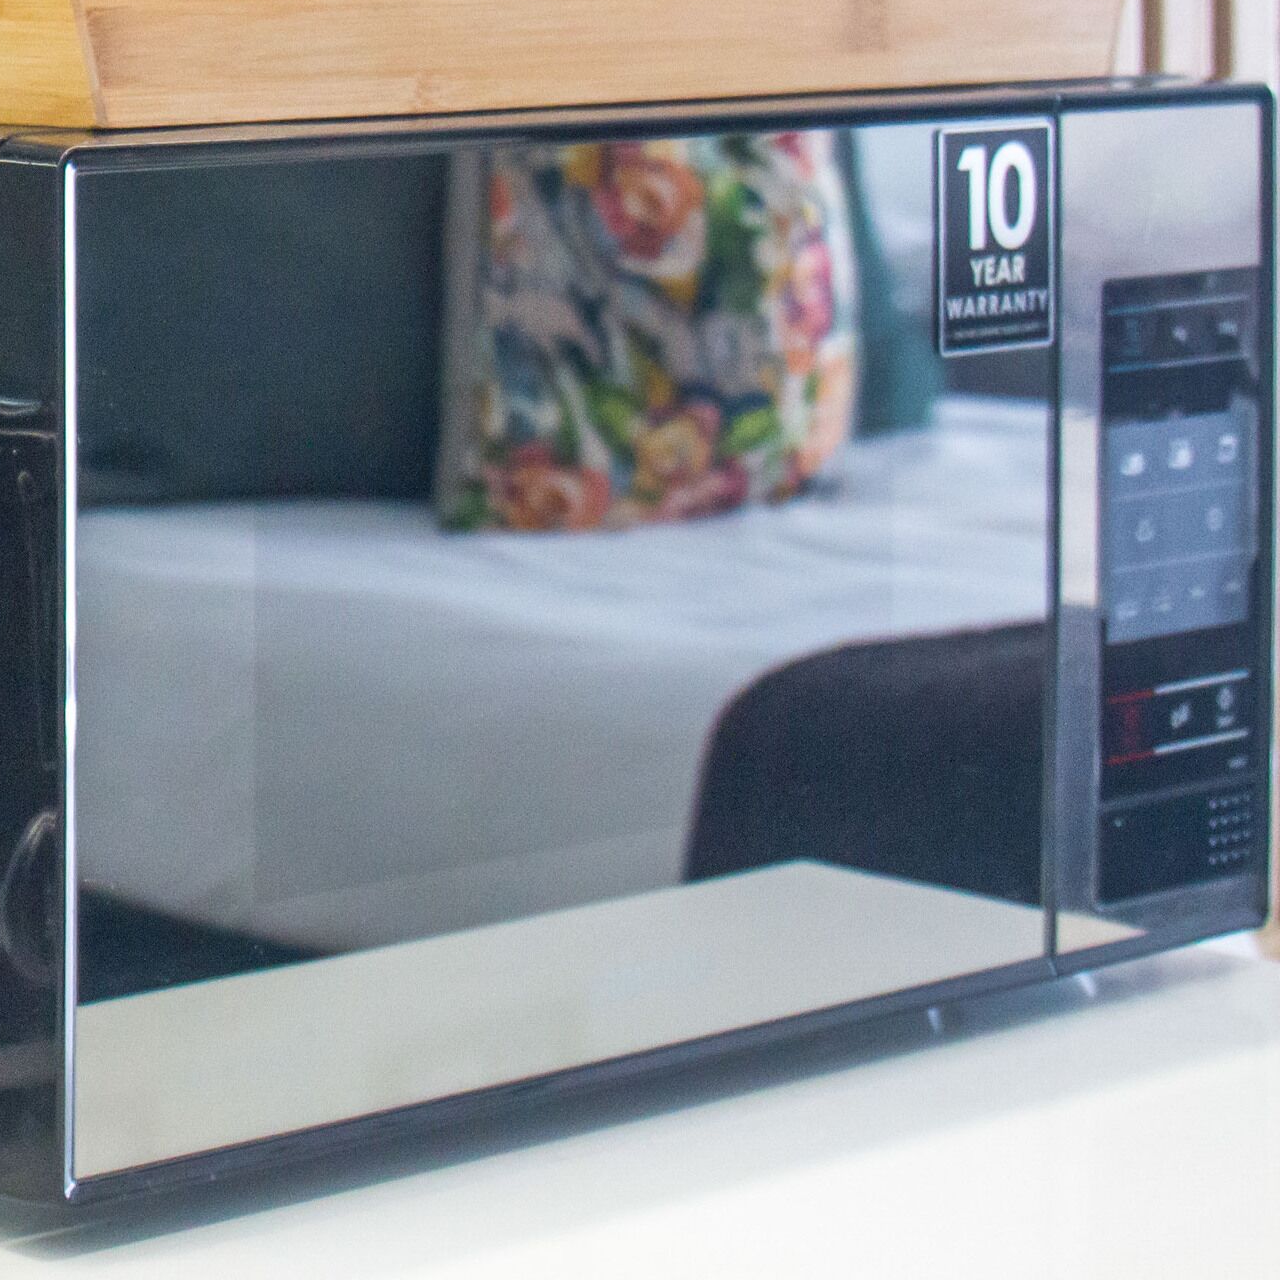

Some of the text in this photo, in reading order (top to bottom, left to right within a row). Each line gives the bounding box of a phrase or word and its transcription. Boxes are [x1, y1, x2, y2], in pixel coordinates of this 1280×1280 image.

[956, 141, 1037, 251] 10
[970, 254, 1026, 288] YEAR
[946, 288, 1048, 320] WARRANTY
